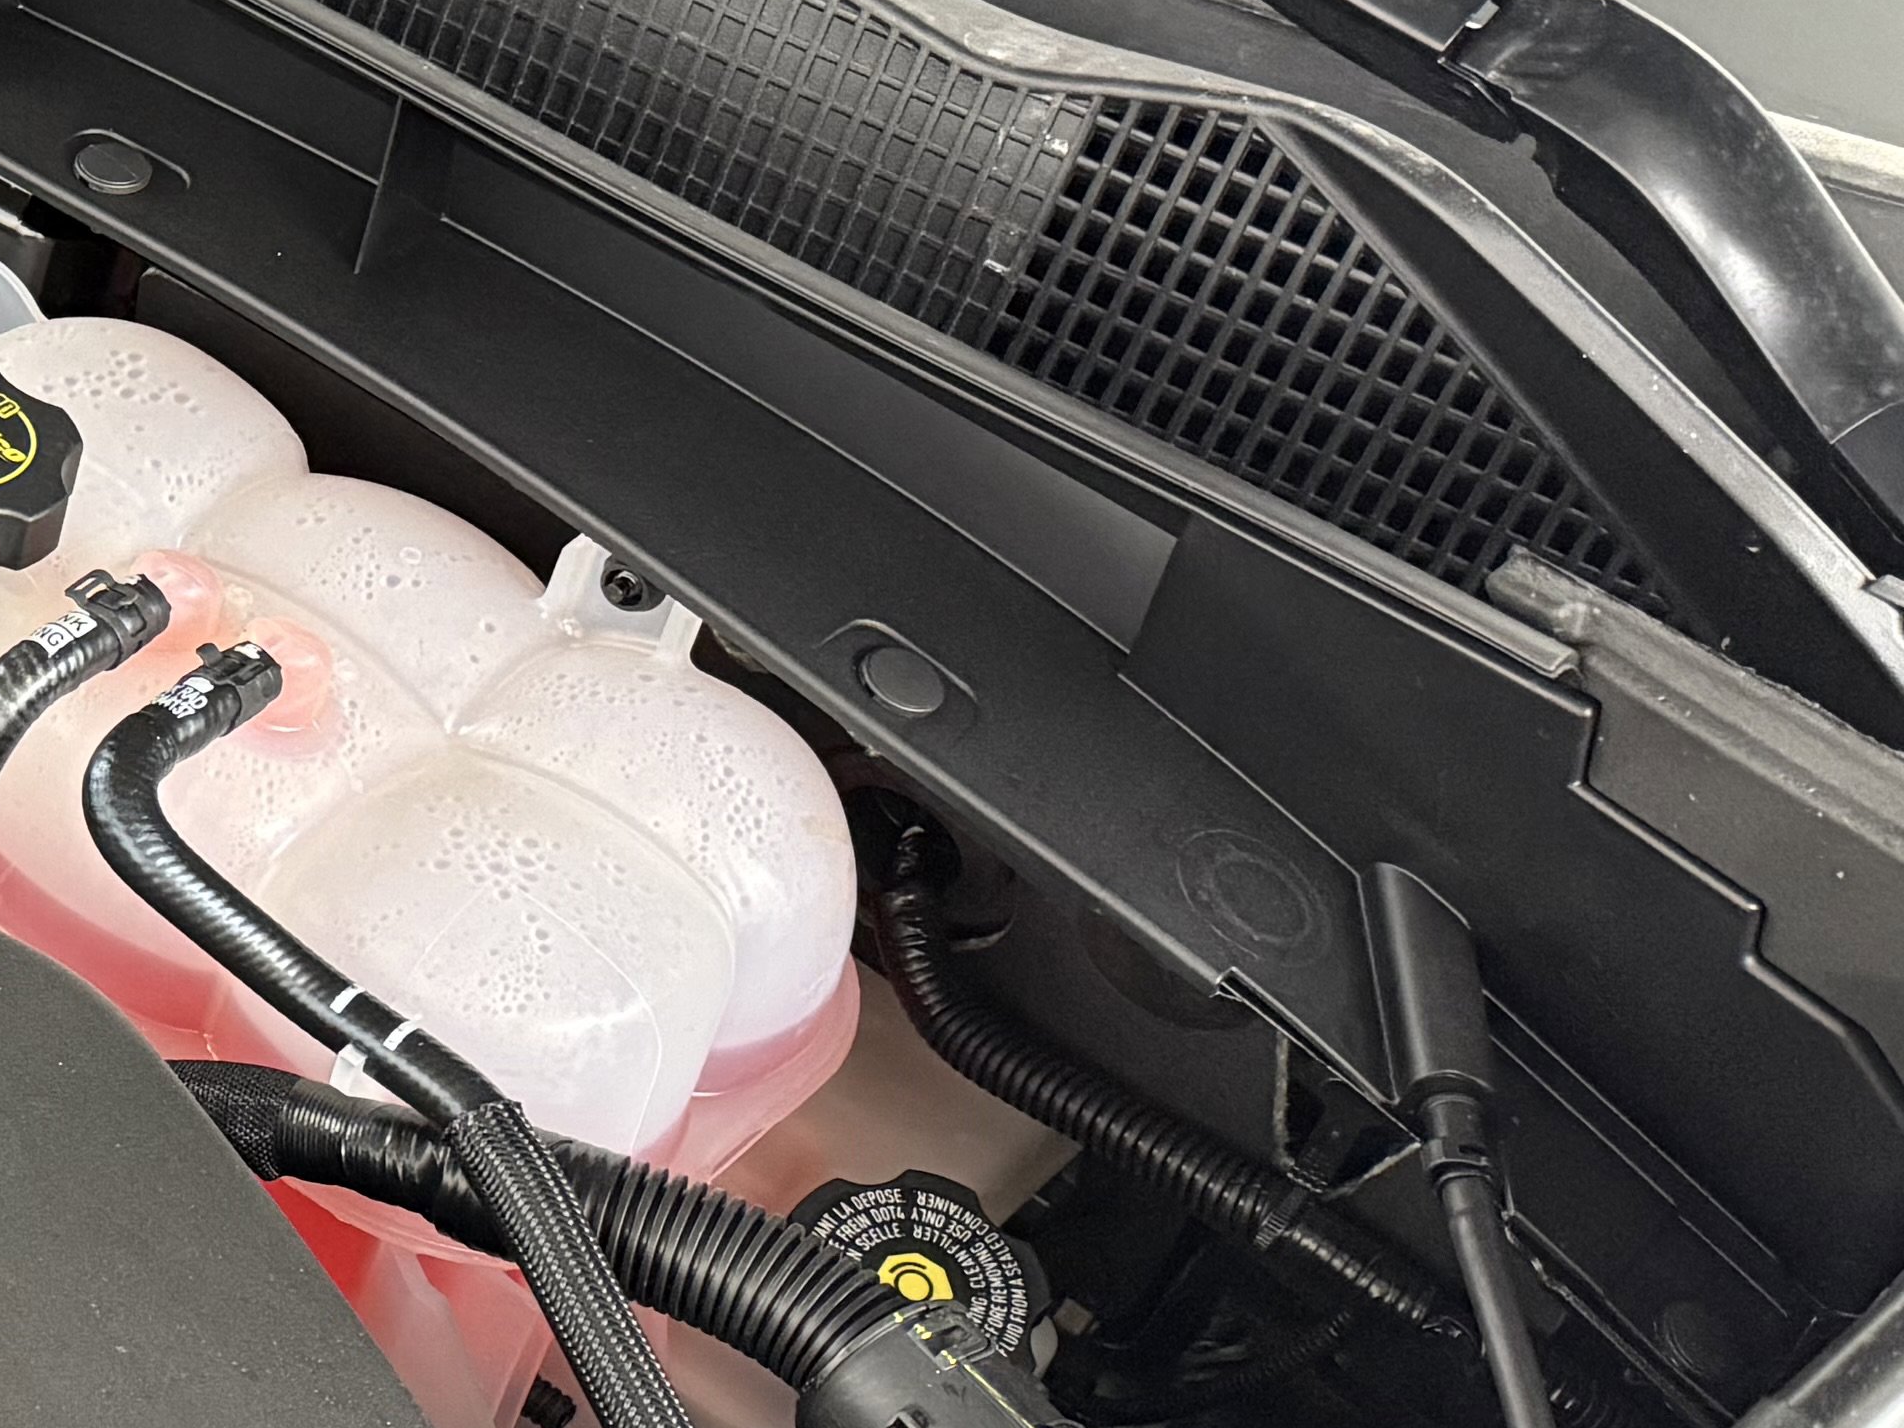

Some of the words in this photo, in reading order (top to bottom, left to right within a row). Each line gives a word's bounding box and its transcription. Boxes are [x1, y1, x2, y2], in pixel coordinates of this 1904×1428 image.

[833, 1198, 852, 1220] LA
[836, 1212, 870, 1242] FREIN
[870, 1205, 905, 1223] DOT4
[910, 1207, 944, 1228] ONLY
[913, 1225, 962, 1255] FILLER
[945, 1216, 972, 1243] USE
[956, 1249, 987, 1290] CLEAN
[985, 1231, 1022, 1277] SEALED
[1010, 1288, 1029, 1326] FROM
[995, 1324, 1024, 1357] FLUID
